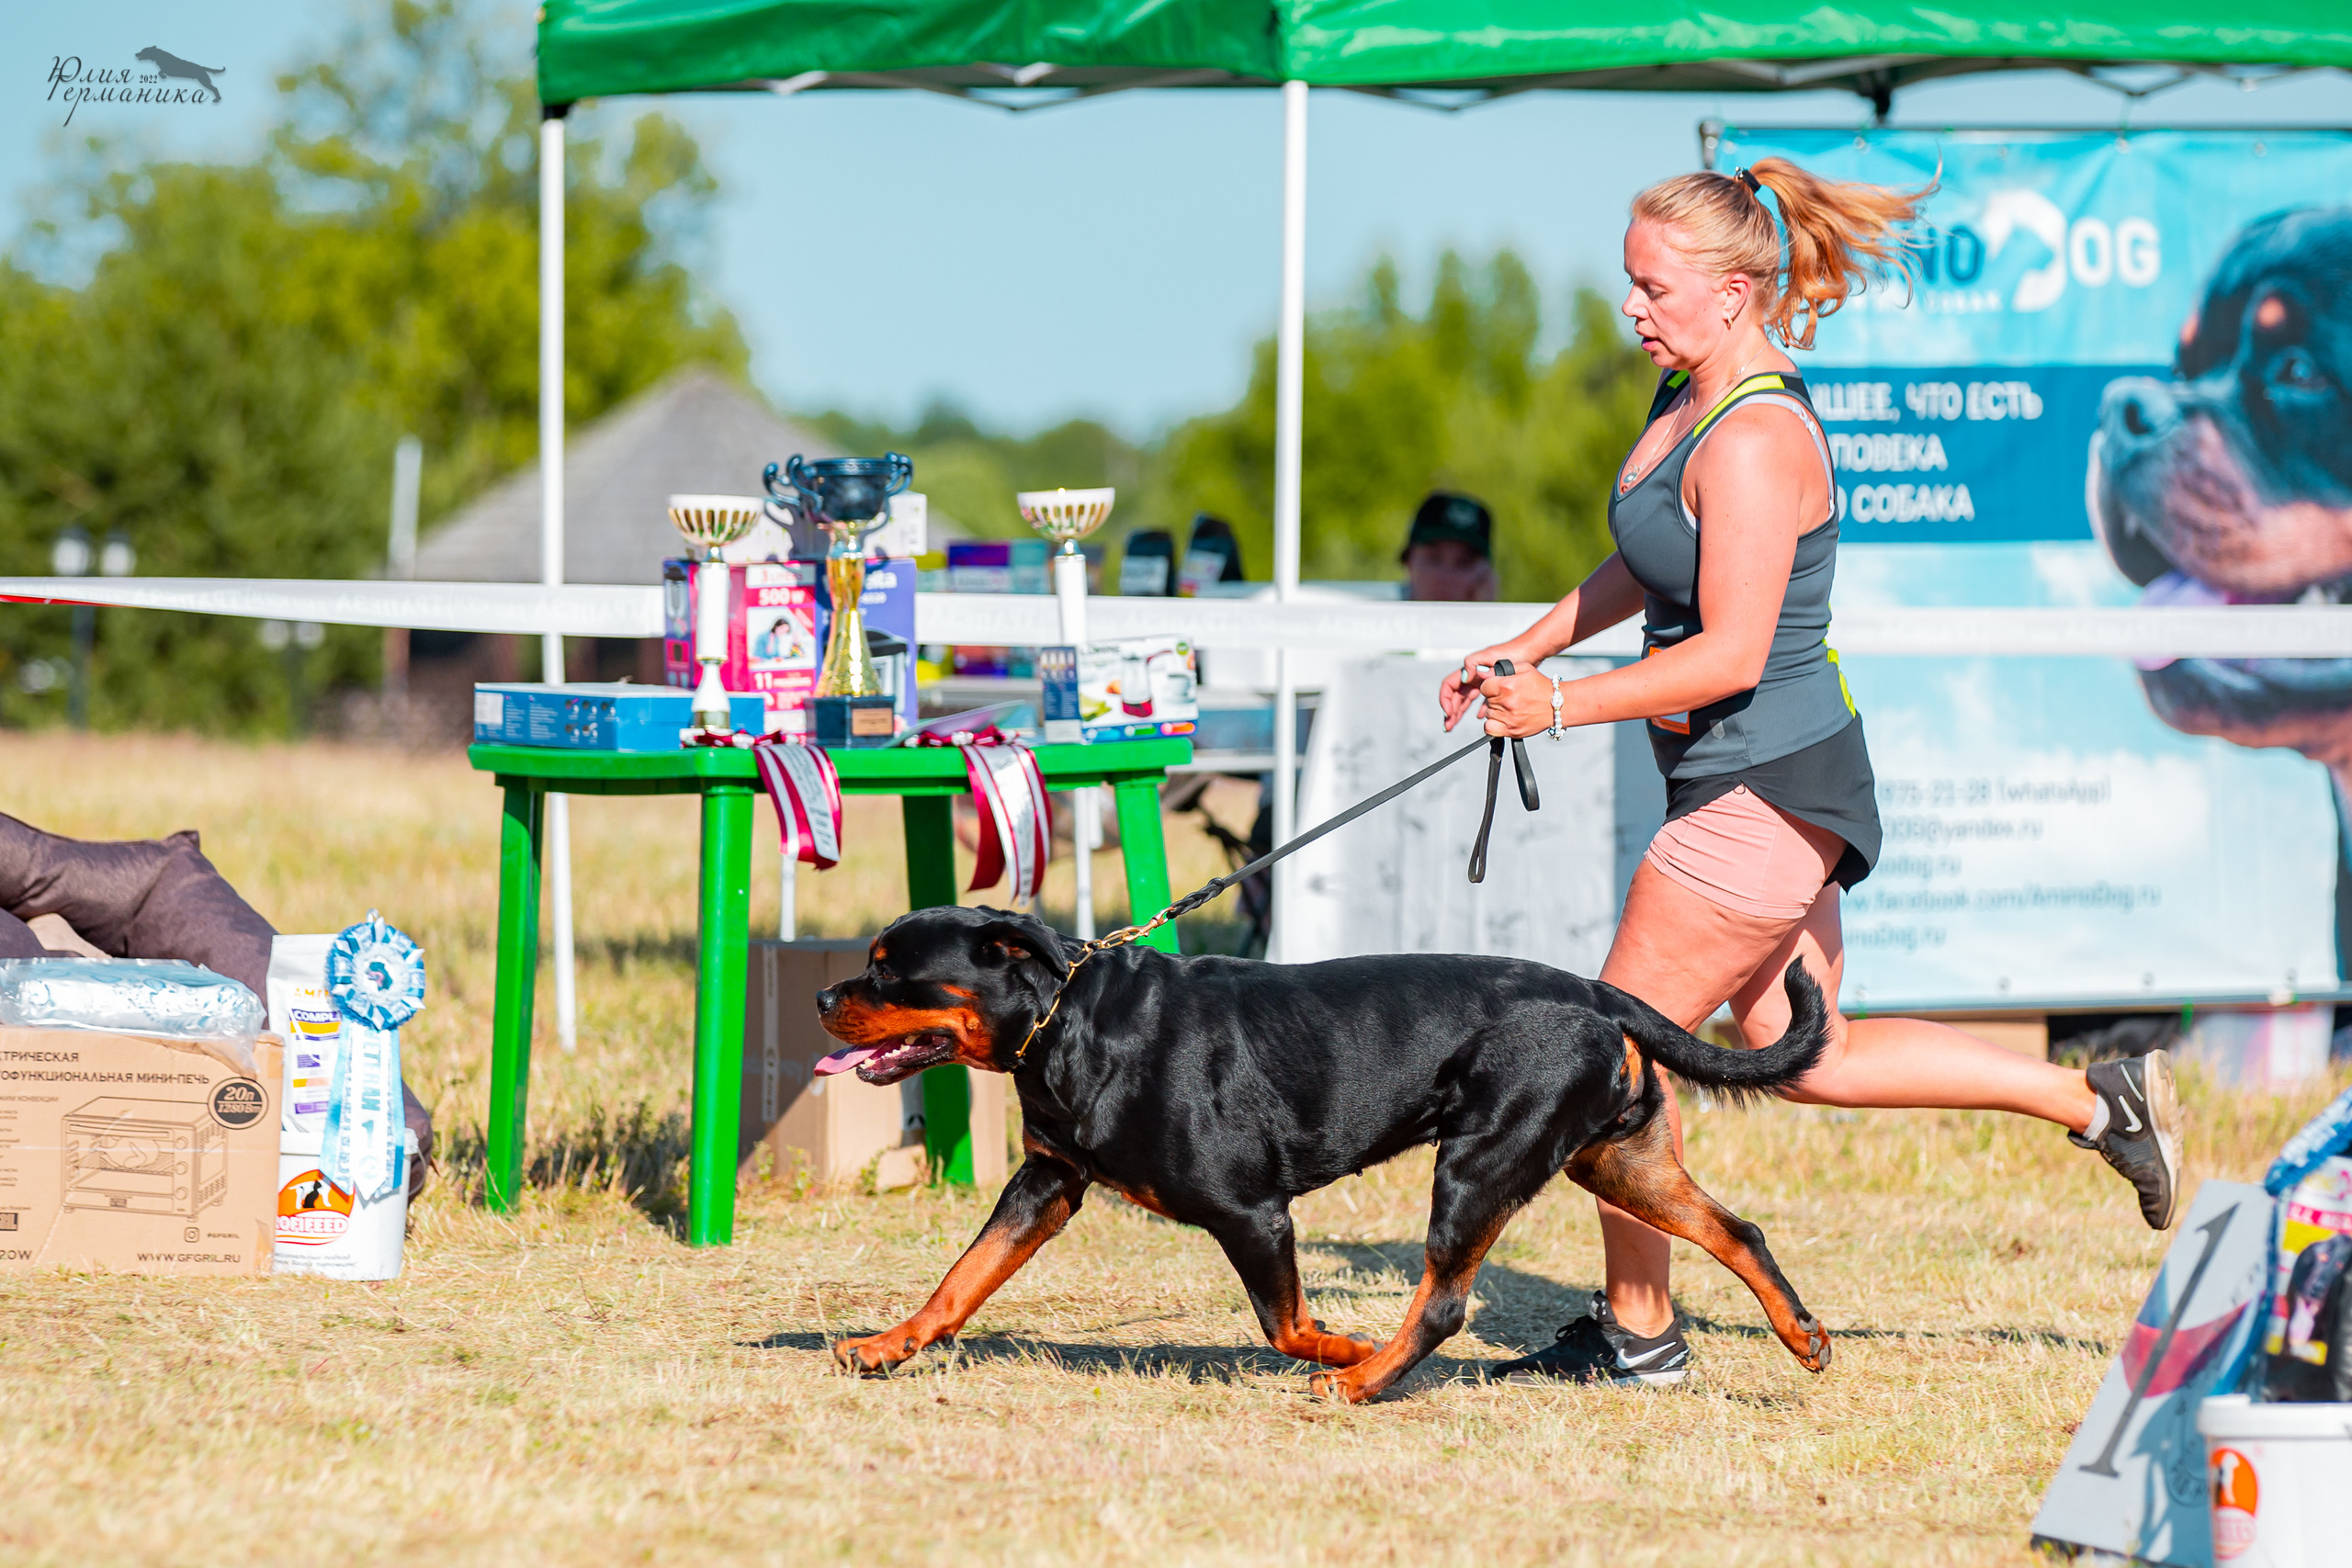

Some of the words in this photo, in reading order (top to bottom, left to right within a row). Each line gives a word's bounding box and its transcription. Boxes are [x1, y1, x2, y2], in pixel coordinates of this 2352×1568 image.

[1905, 381, 1963, 421] ЧТО
[1965, 381, 2044, 421] ЕСТЬ
[1850, 482, 1974, 523] СОБАКА
[0, 1070, 133, 1083] ОФУНКЦИОНАЛЬНАЯ
[137, 1072, 209, 1085] МИНИ-ПЕЧЬ
[2079, 1202, 2241, 1479] 1
